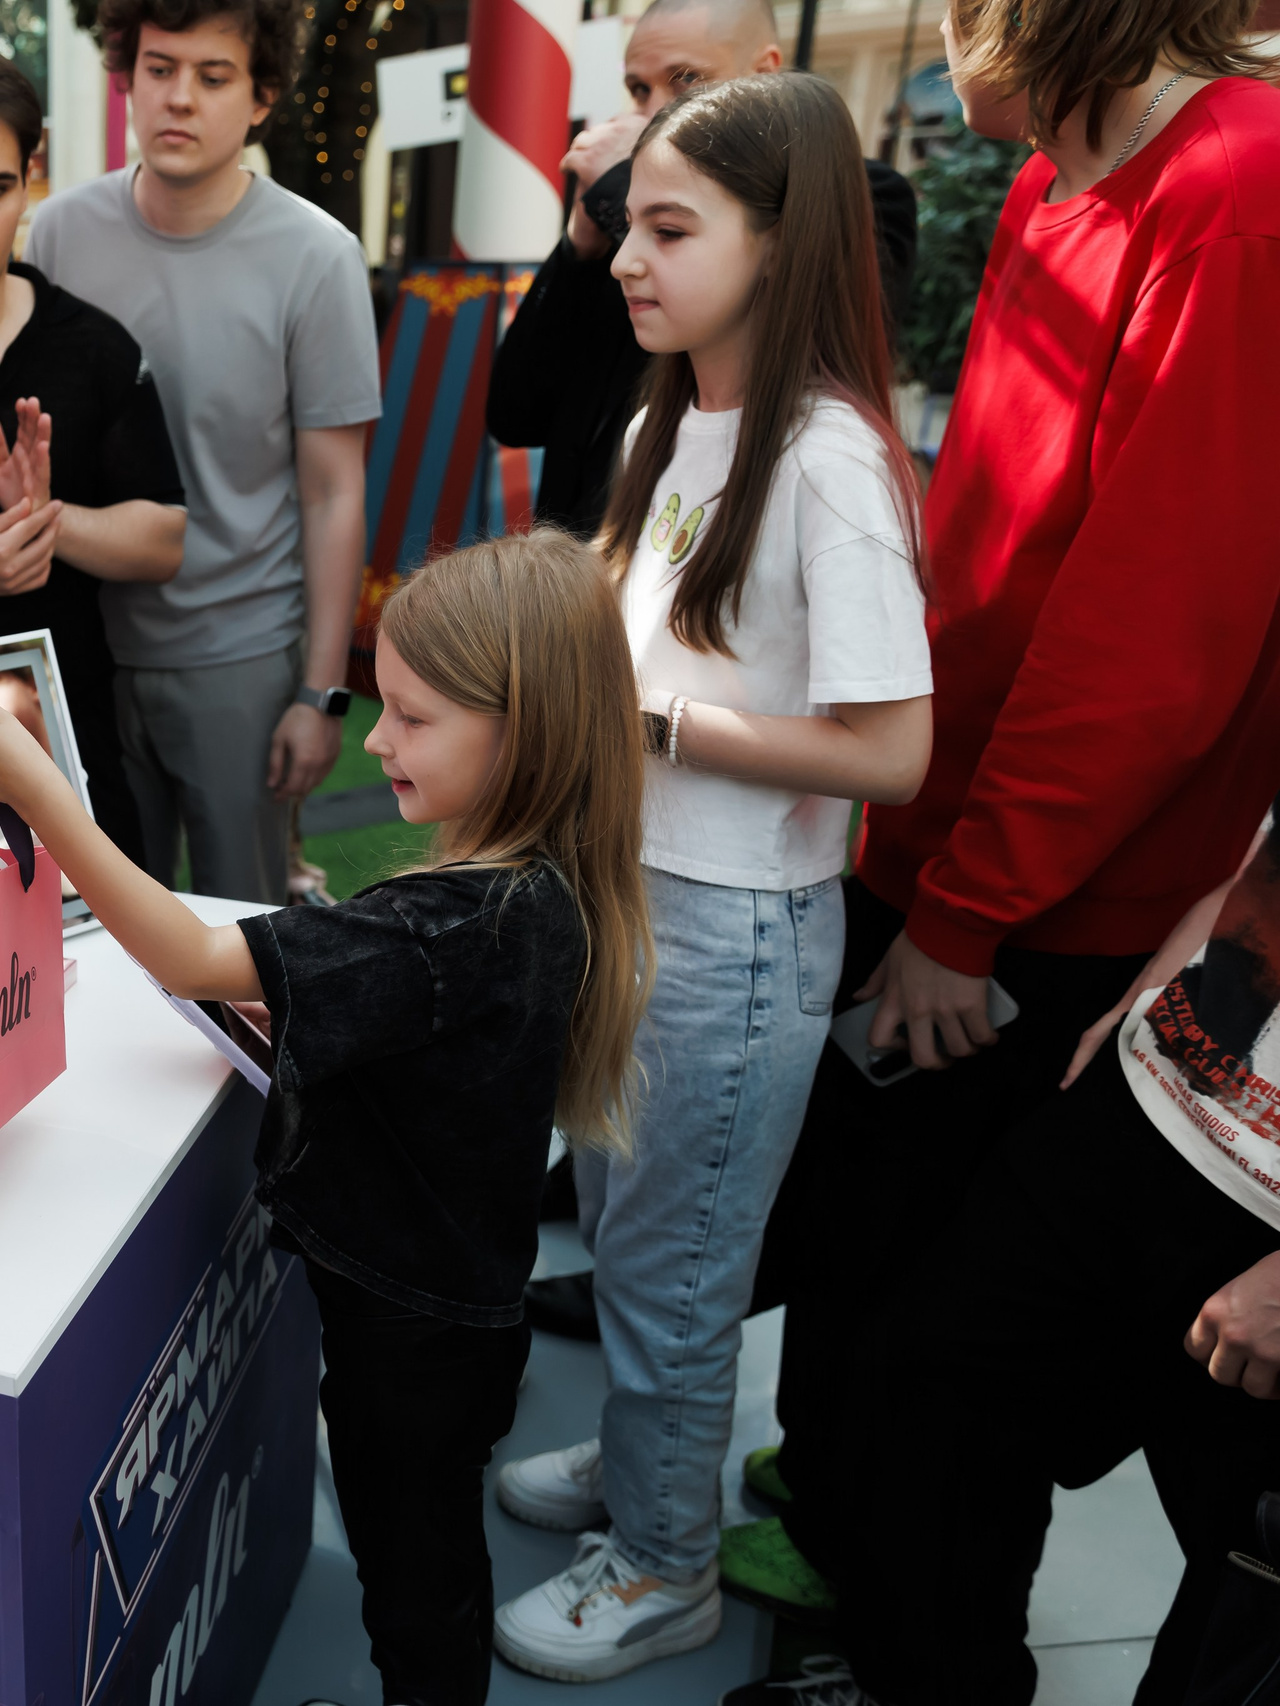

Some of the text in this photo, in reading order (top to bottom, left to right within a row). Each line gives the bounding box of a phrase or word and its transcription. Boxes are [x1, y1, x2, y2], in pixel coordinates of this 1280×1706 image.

[1192, 1102, 1240, 1143] STUDIOS
[1237, 1156, 1251, 1174] FL
[1252, 1167, 1280, 1198] 3312
